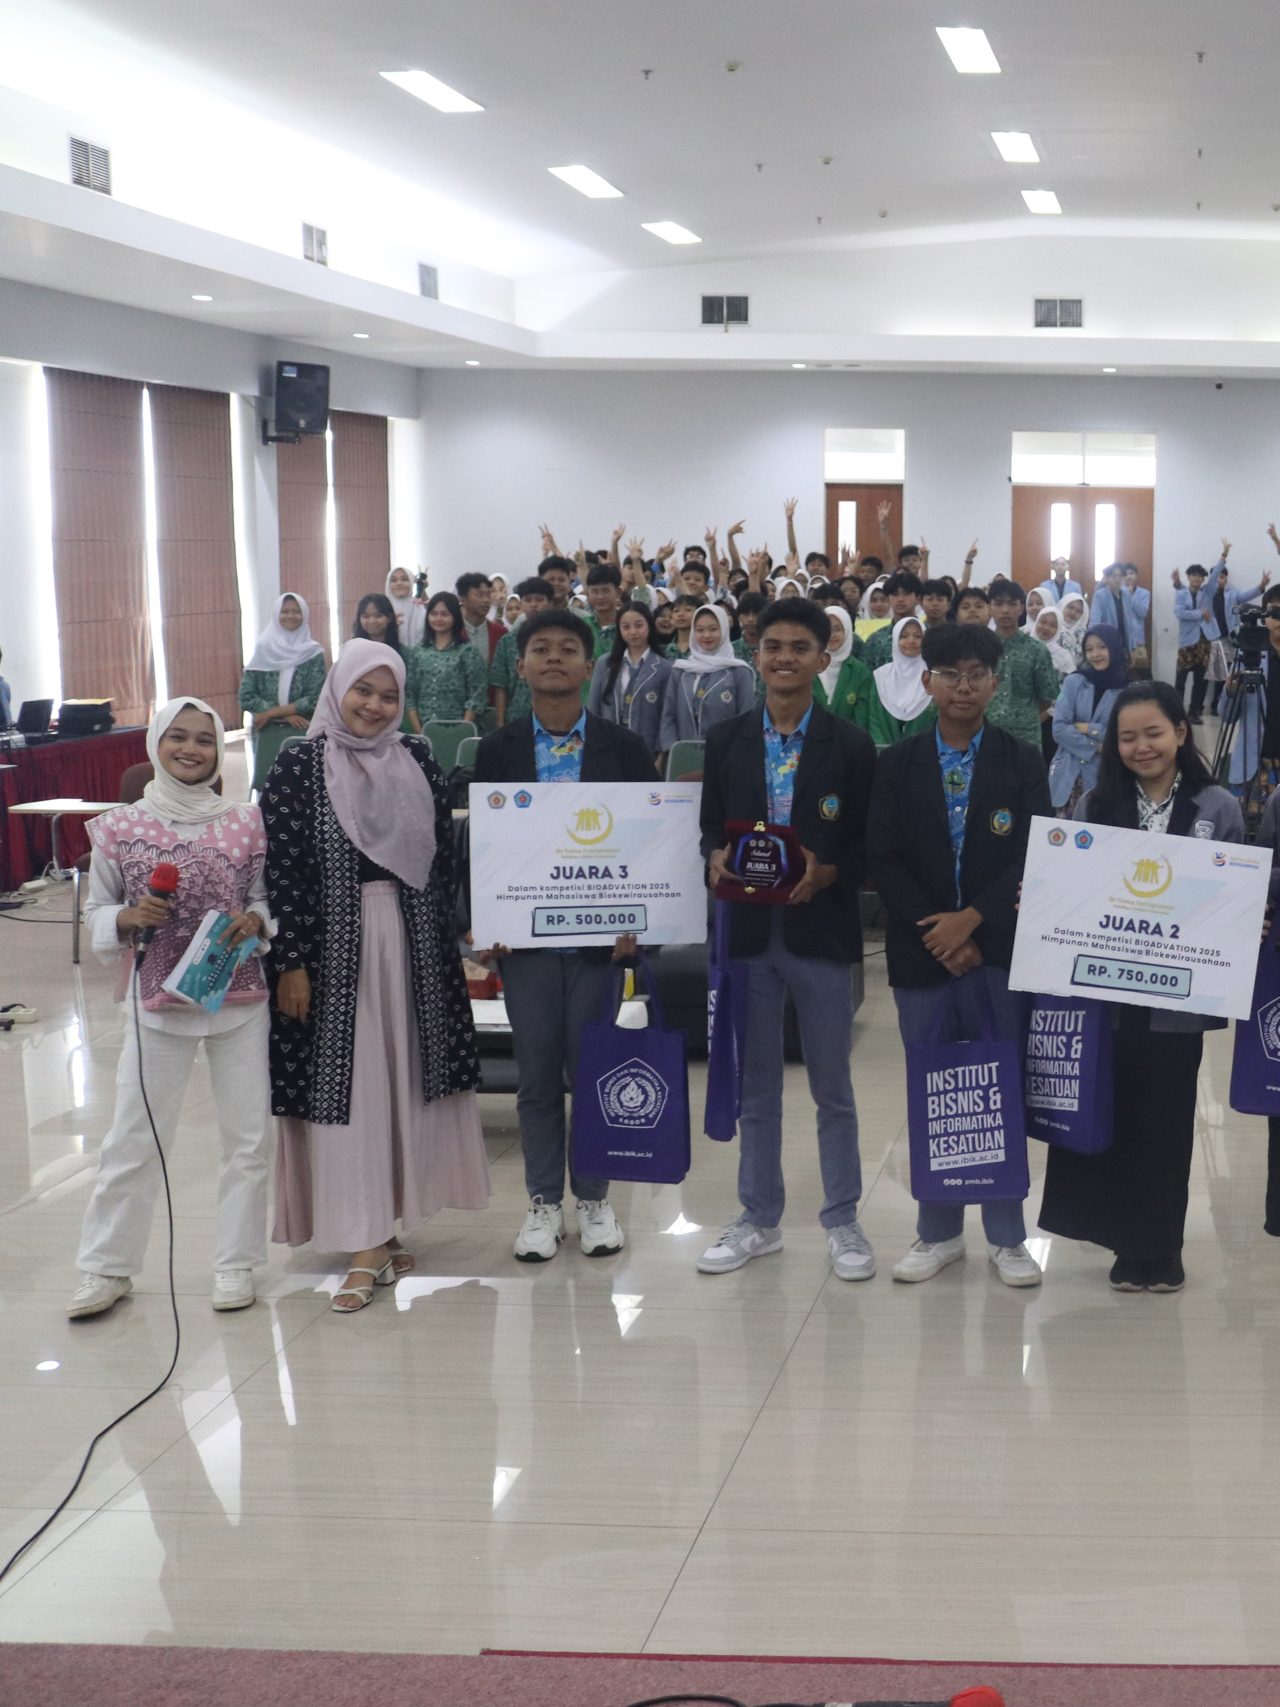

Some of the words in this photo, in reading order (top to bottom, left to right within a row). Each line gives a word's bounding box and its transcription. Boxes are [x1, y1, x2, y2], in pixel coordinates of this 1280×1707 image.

[550, 865, 613, 880] JUARA
[618, 864, 628, 879] 3
[746, 862, 768, 870] JUARA
[496, 893, 544, 901] Himpunan
[540, 884, 584, 893] kompetisi
[587, 883, 646, 891] BIOADVATION
[546, 914, 570, 926] RP.
[576, 913, 636, 926] 500,000
[1099, 914, 1164, 938] JUARA
[1169, 924, 1180, 939] 2
[1042, 934, 1088, 948] Himpunan
[1091, 942, 1143, 956] Mahasiswa
[1146, 949, 1231, 968] Biokewirausahaan
[1054, 927, 1084, 938] Dalam
[1086, 931, 1132, 945] kompetisi
[1134, 938, 1197, 954] BIOADVATION
[1199, 948, 1221, 957] 2025
[1088, 964, 1111, 978] RP.
[1070, 1036, 1082, 1058] &
[927, 1062, 999, 1094] INSTITUT
[928, 1090, 984, 1118] BISNIS
[989, 1087, 1002, 1110] &
[928, 1112, 1003, 1136] INFORMATIKA
[929, 1129, 1004, 1158] KESATUAN
[938, 1152, 998, 1166] www.ibik.ac.id
